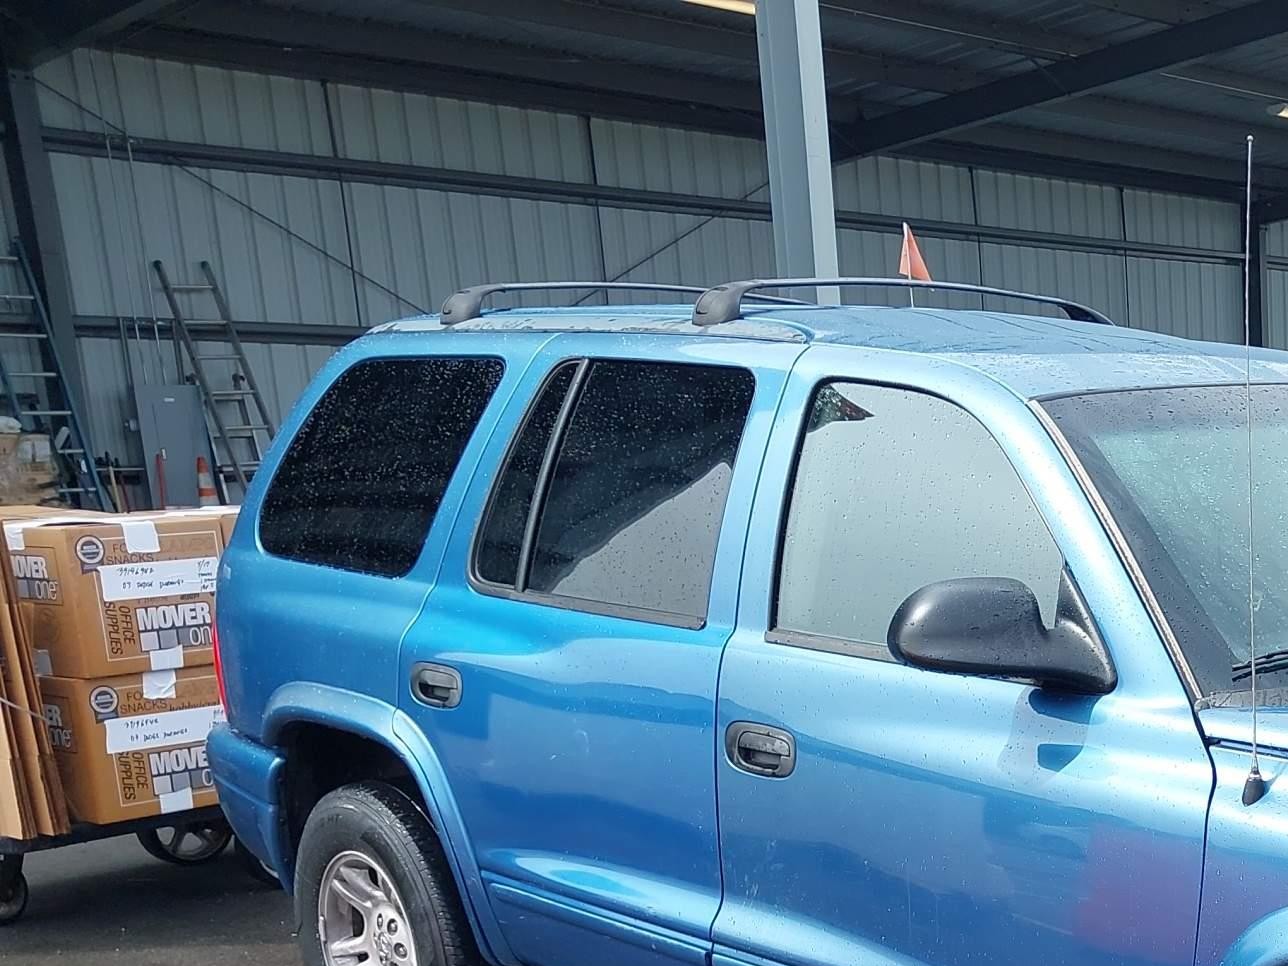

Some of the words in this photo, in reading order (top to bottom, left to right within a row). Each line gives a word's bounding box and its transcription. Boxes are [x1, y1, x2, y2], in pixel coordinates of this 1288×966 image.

[106, 553, 153, 565] SNACKS
[105, 602, 123, 654] SUPPLIES
[119, 605, 136, 645] OFFICE
[137, 602, 211, 631] MOVER
[190, 626, 213, 645] on
[120, 699, 167, 714] SNACKS
[132, 752, 149, 790] OFFICE
[151, 746, 208, 776] MOVE
